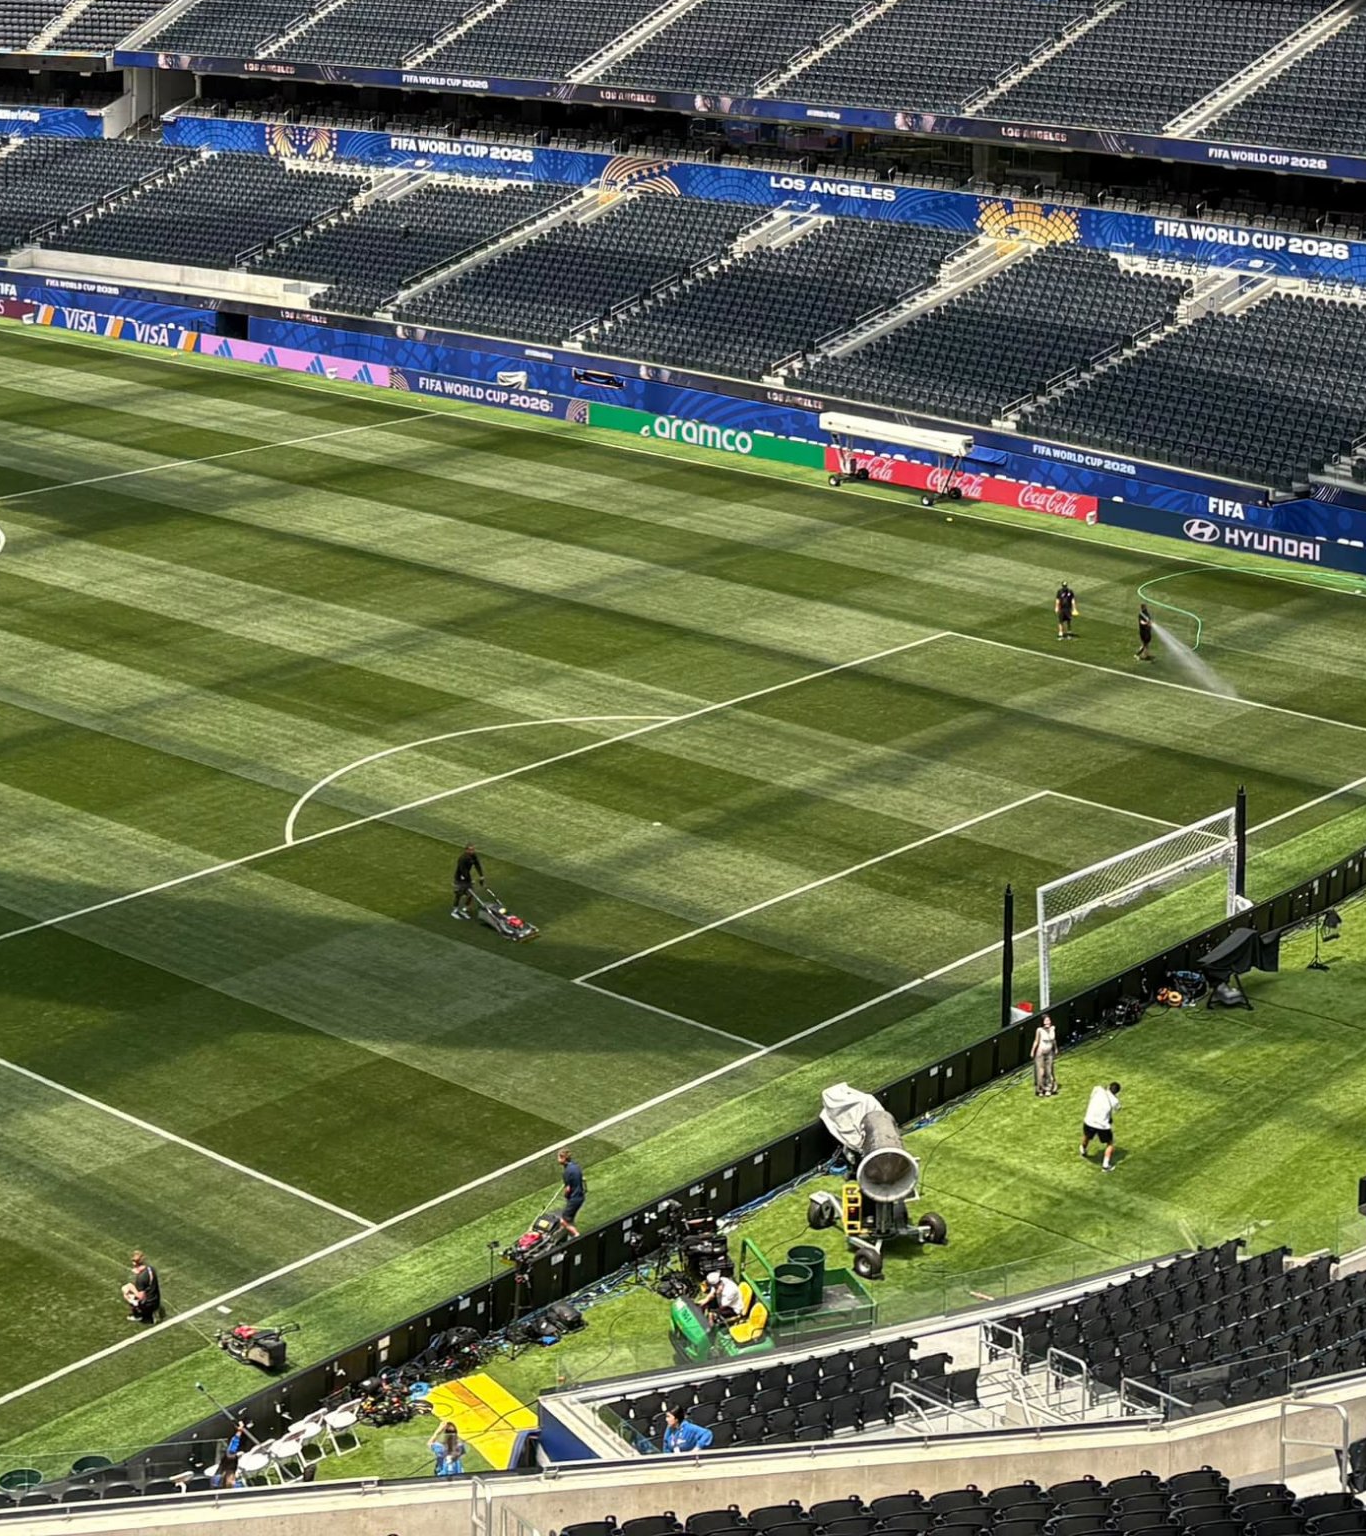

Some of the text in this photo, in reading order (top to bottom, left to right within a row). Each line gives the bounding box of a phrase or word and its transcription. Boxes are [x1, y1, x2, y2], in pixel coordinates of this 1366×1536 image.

[1001, 126, 1020, 138] LOS
[390, 137, 534, 162] FIFA WORLD CUP 2026
[1208, 147, 1327, 170] FIFA WORLD CUP 2026
[770, 175, 896, 202] LOS ANGELES
[1155, 220, 1349, 260] FIFA WORLD CUP 2026
[63, 309, 97, 334] VISA
[133, 322, 170, 347] VISA
[419, 376, 553, 412] FIFA WORLD CUP 2026
[654, 416, 753, 454] aramco
[1032, 444, 1137, 475] FIFA WORLD CUP 2026
[1017, 486, 1076, 518] Coca-Cola
[1208, 495, 1245, 520] FIFA
[1225, 527, 1321, 561] HYUNDAI
